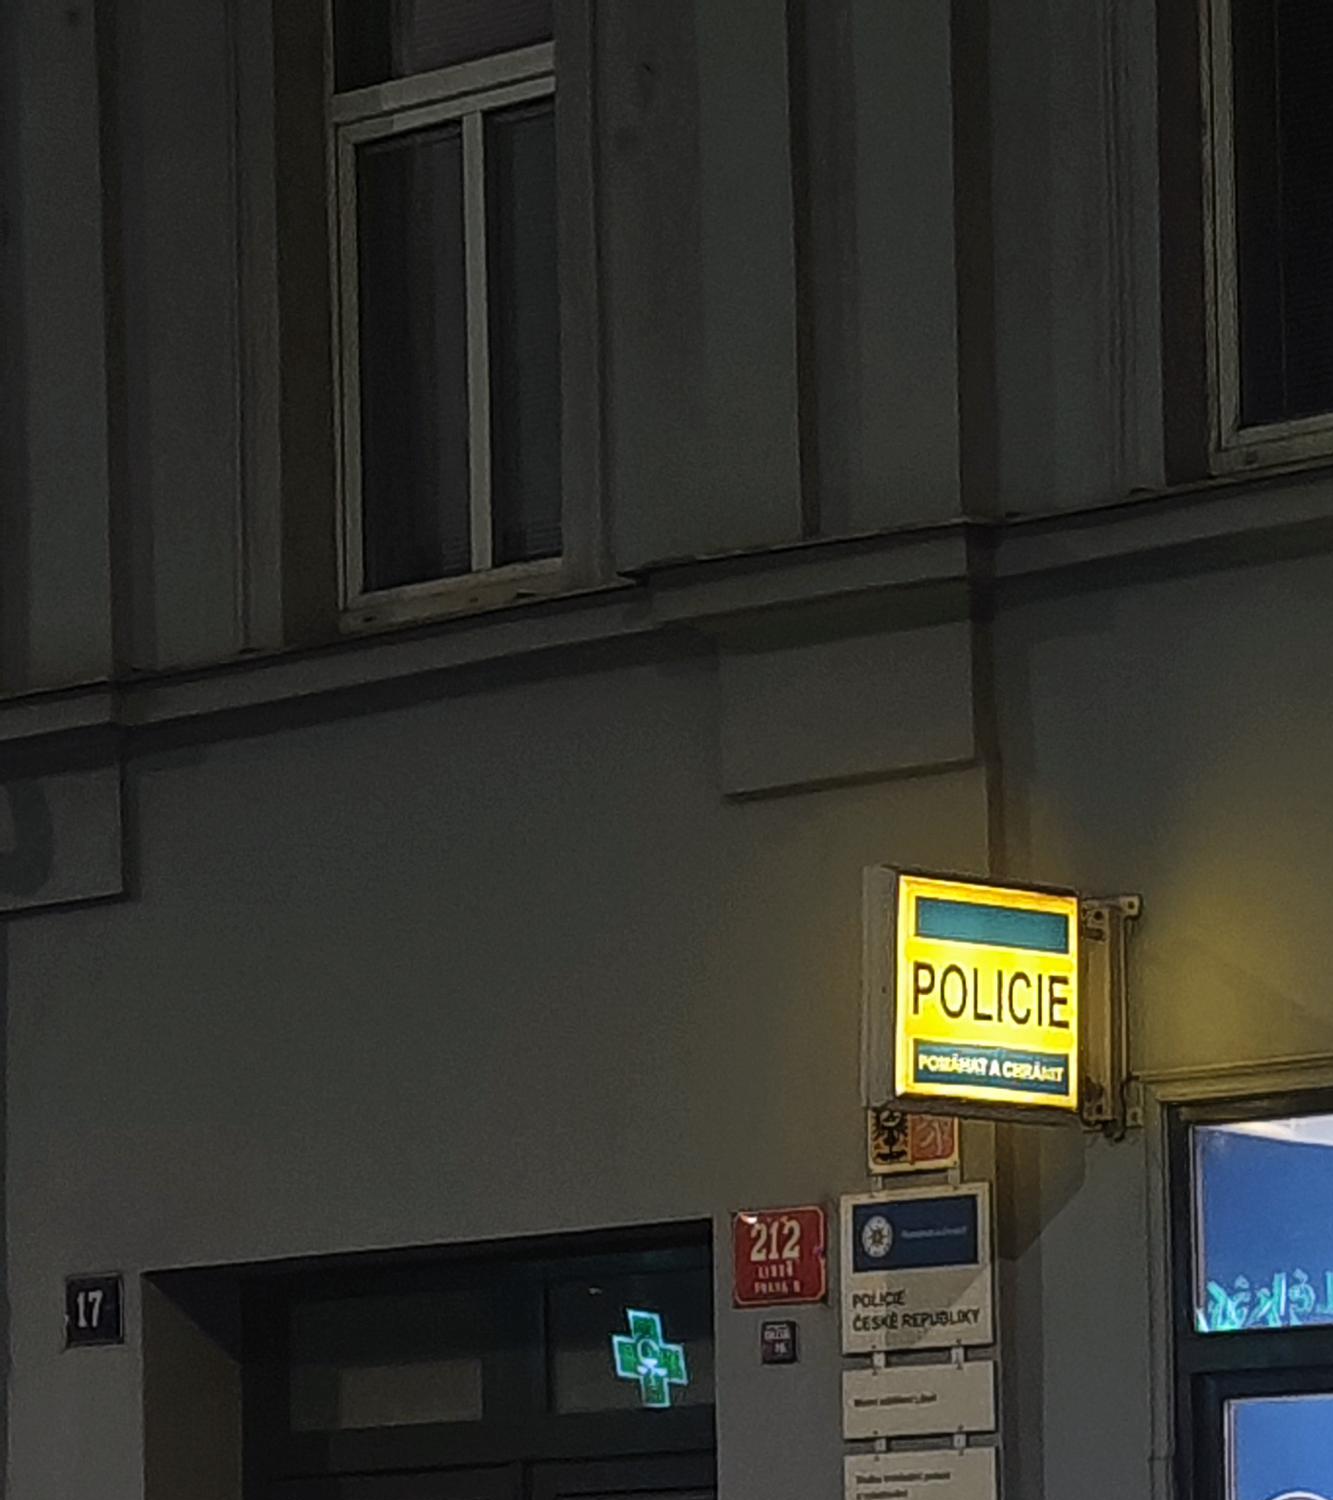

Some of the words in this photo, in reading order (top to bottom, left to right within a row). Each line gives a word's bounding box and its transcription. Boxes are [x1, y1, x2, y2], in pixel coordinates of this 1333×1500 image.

[912, 961, 1070, 1029] POLICIE
[750, 1218, 800, 1261] 212
[77, 1290, 103, 1328] 17
[852, 1289, 906, 1308] POLICIE
